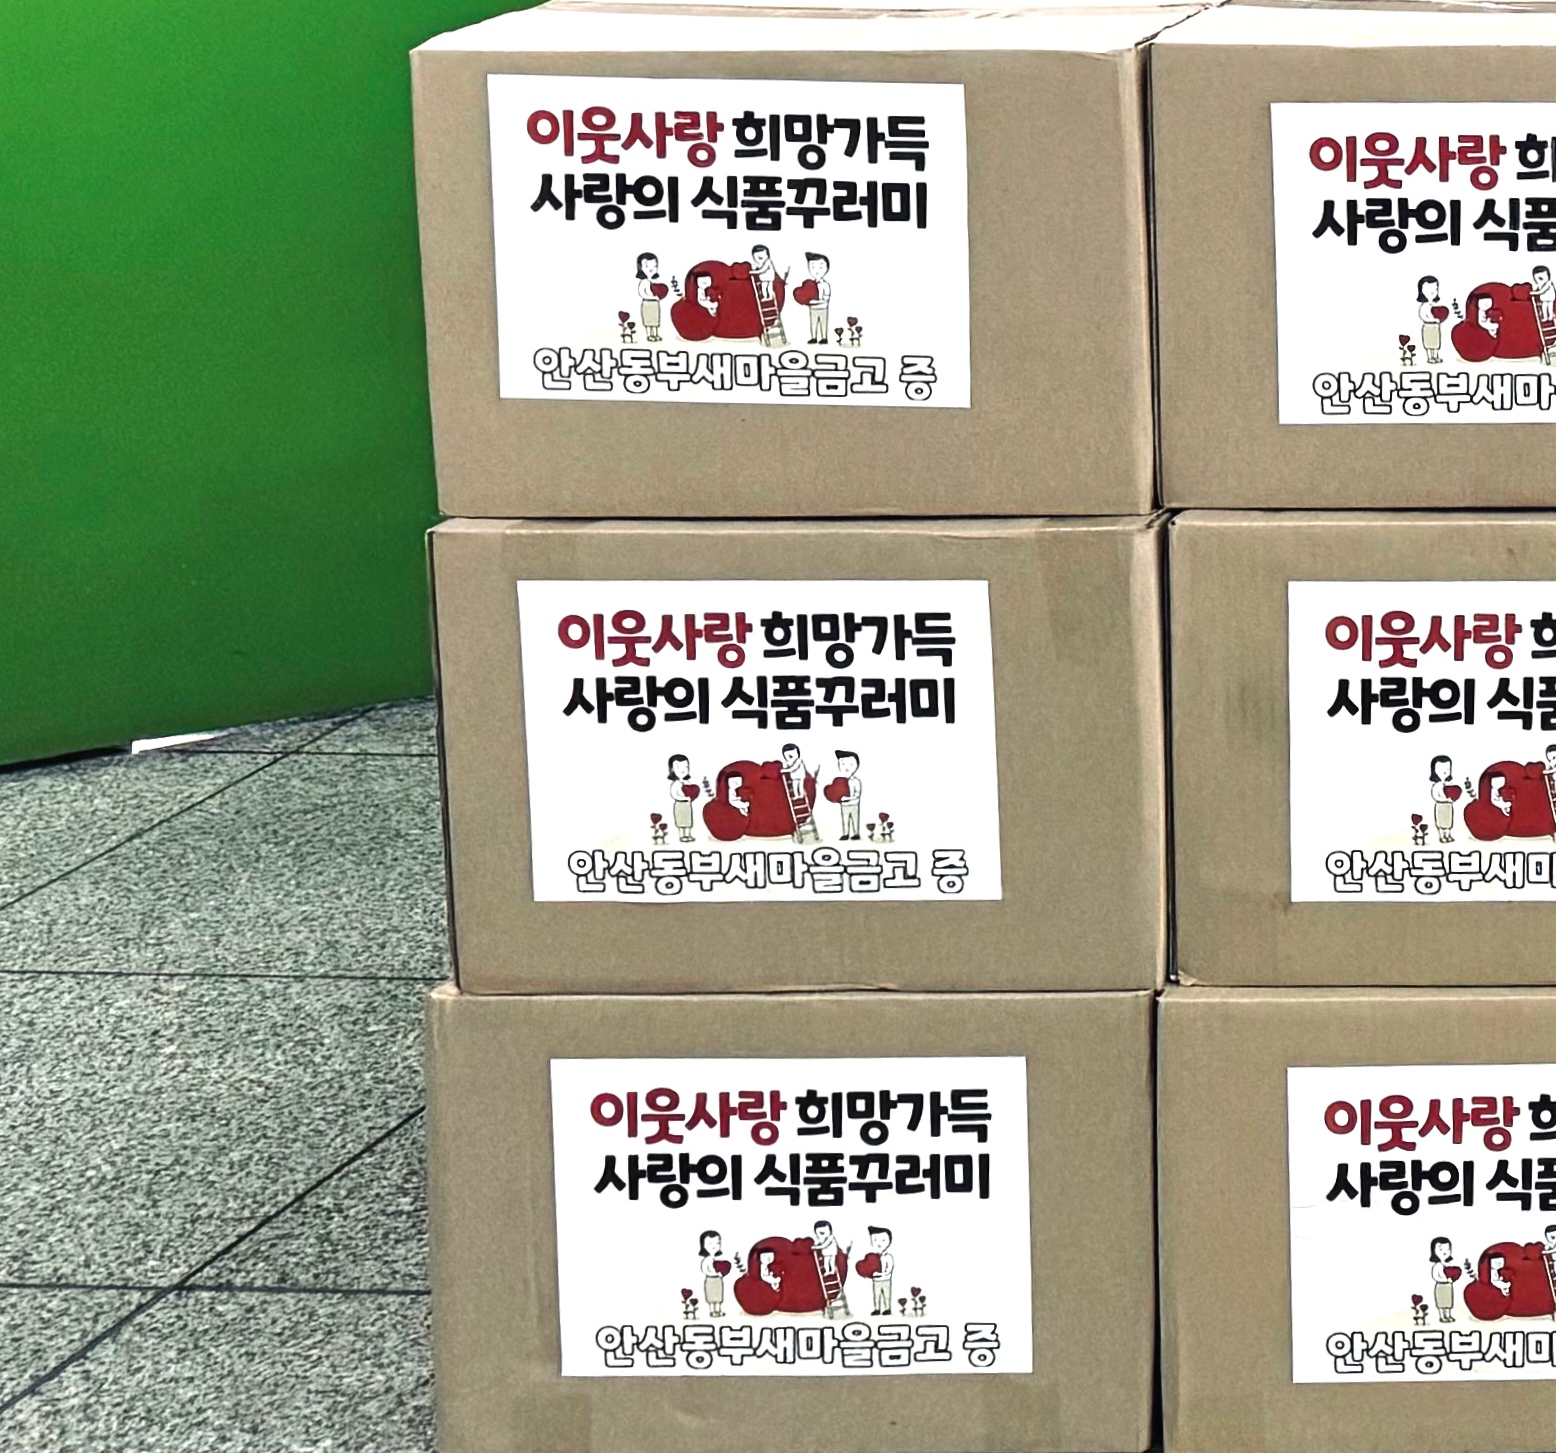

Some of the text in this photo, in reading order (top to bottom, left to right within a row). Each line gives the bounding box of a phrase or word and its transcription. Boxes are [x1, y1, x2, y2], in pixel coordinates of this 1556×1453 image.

[525, 105, 931, 173] 이웃사랑 희망가득
[529, 171, 928, 233] 사랑의 식품꾸러미
[532, 346, 939, 402] 안산동부새마을금고 증
[1323, 610, 1523, 670] 이웃사랑
[1325, 675, 1477, 734] 사랑의
[588, 1087, 993, 1147] 이웃사랑 희망가득
[592, 1150, 991, 1210] 사랑의 식품꾸러미
[595, 1321, 1002, 1370] 안산동부새마을금고 증
